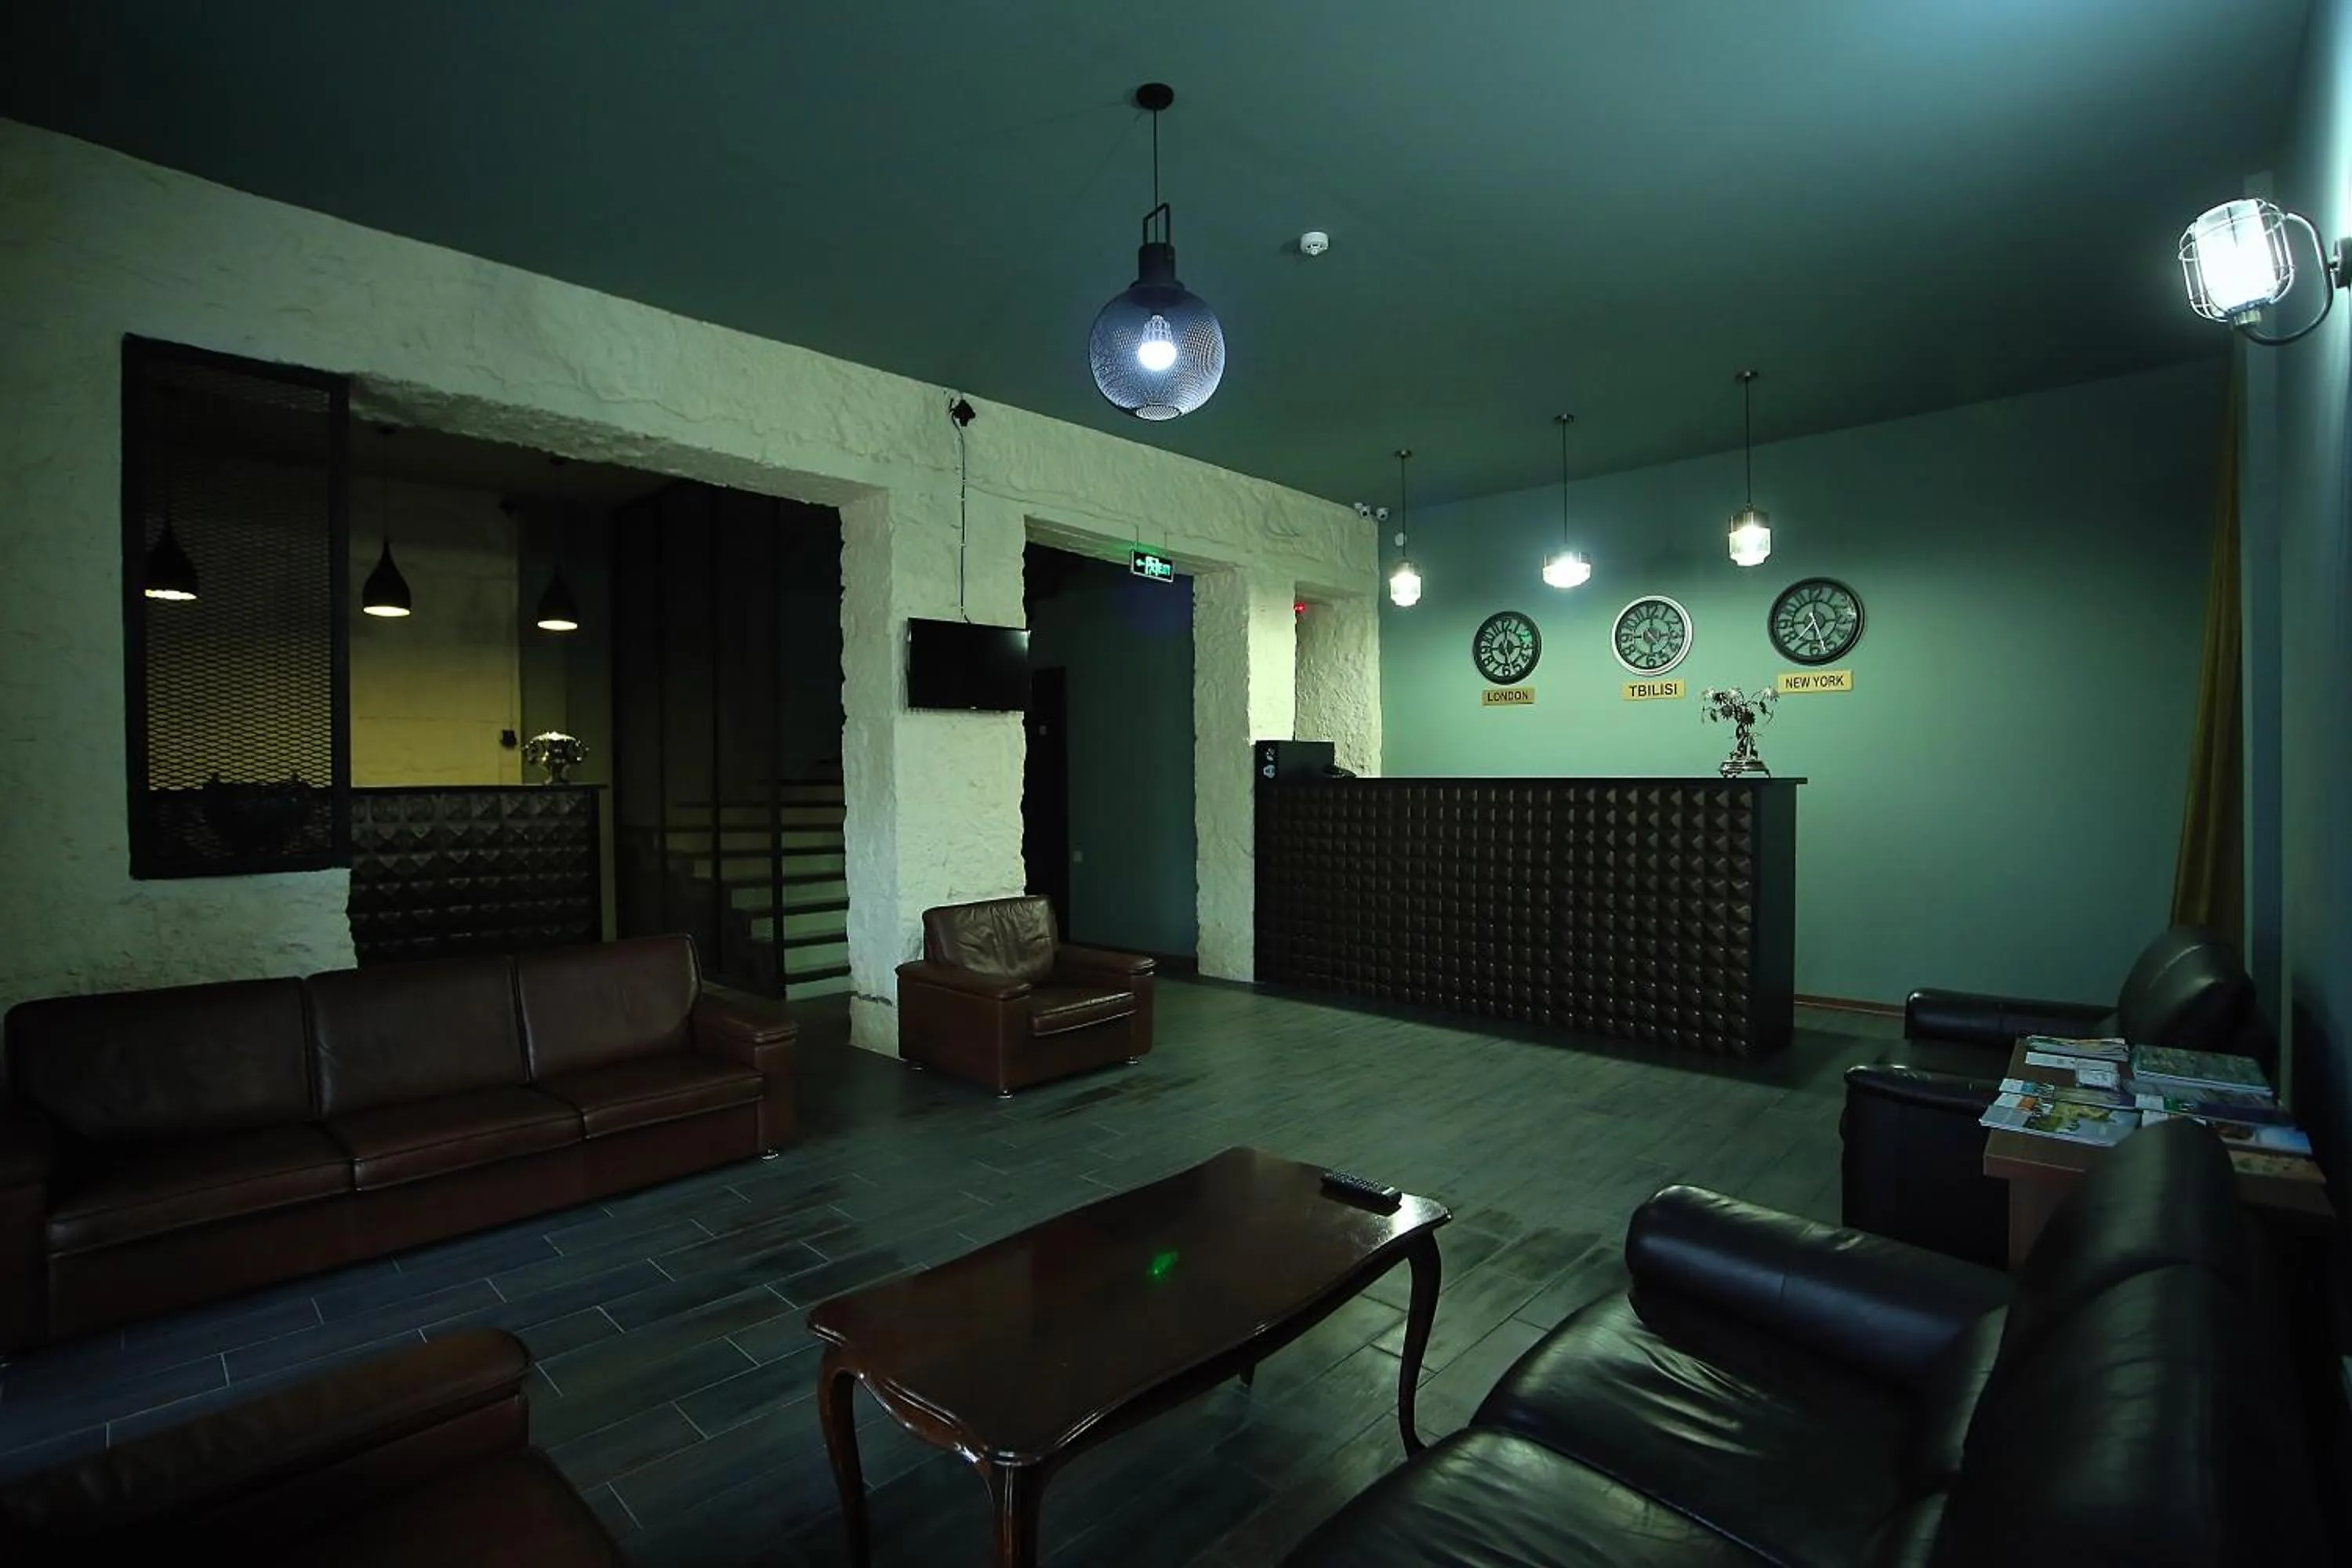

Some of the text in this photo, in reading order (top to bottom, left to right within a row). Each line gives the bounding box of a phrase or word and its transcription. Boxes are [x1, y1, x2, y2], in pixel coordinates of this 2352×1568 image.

[1785, 675, 1844, 689] NEW YORK
[1487, 691, 1528, 702] LONDON
[1628, 683, 1677, 697] TBILISI
